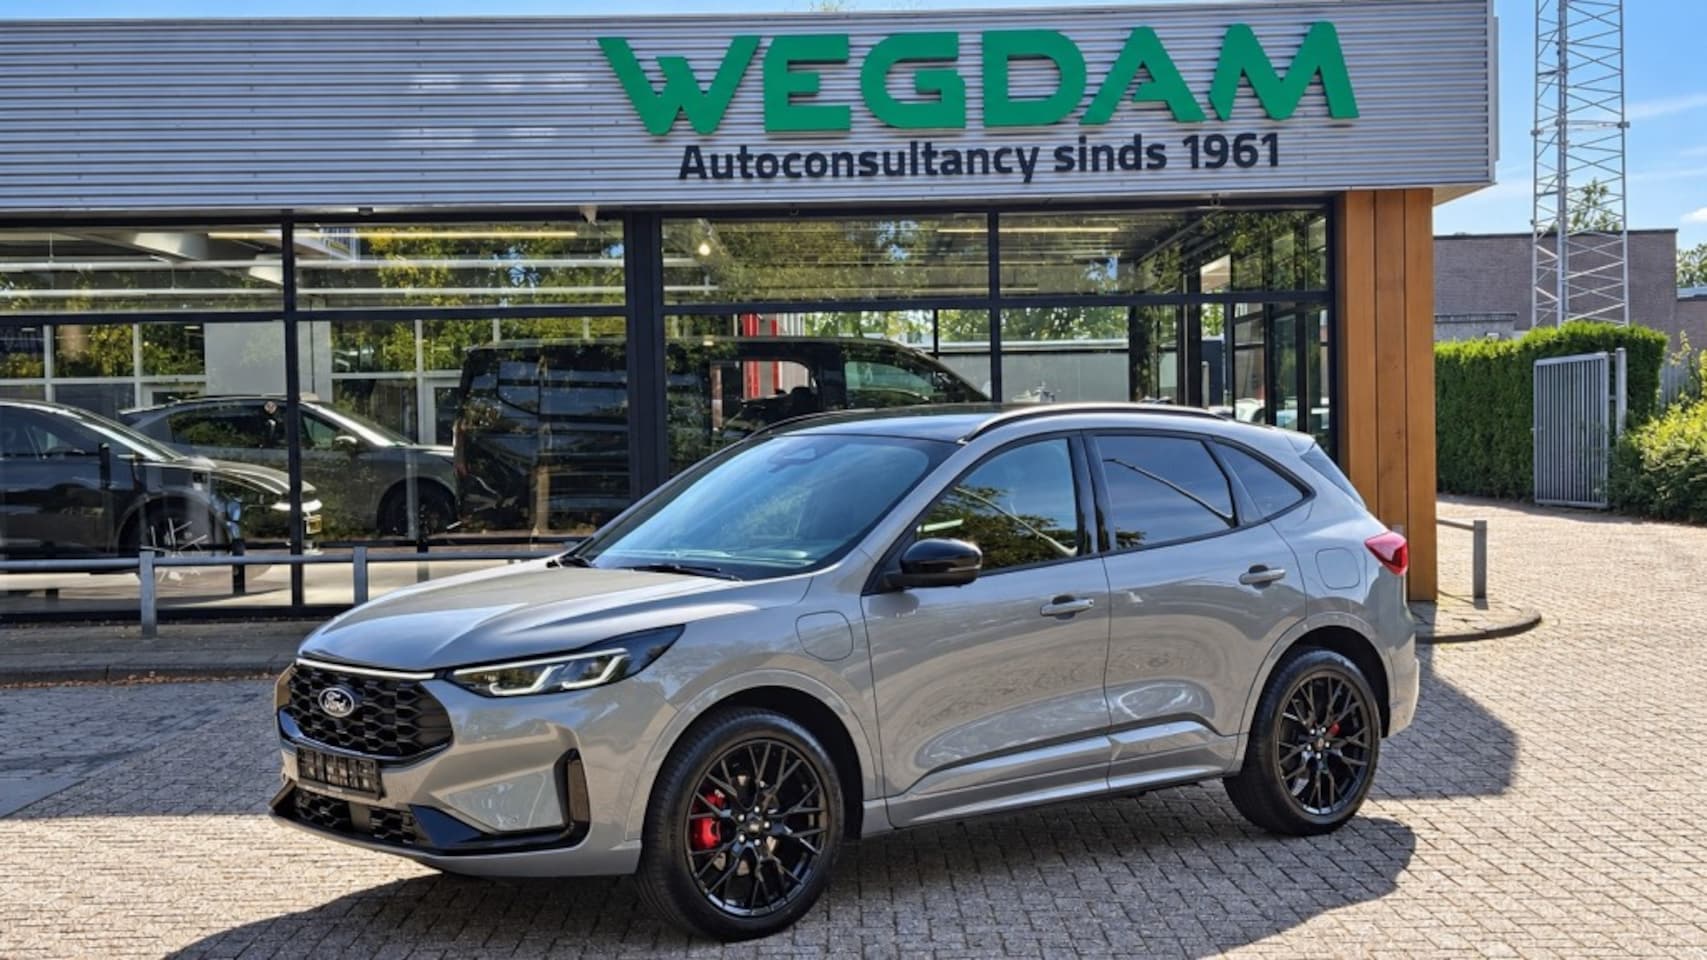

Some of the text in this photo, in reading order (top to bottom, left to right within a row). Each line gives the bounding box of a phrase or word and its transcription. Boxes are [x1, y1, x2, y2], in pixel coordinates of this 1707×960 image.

[597, 21, 1360, 136] WEGDAM
[678, 132, 1279, 184] Autoconsultancy sinds 1961
